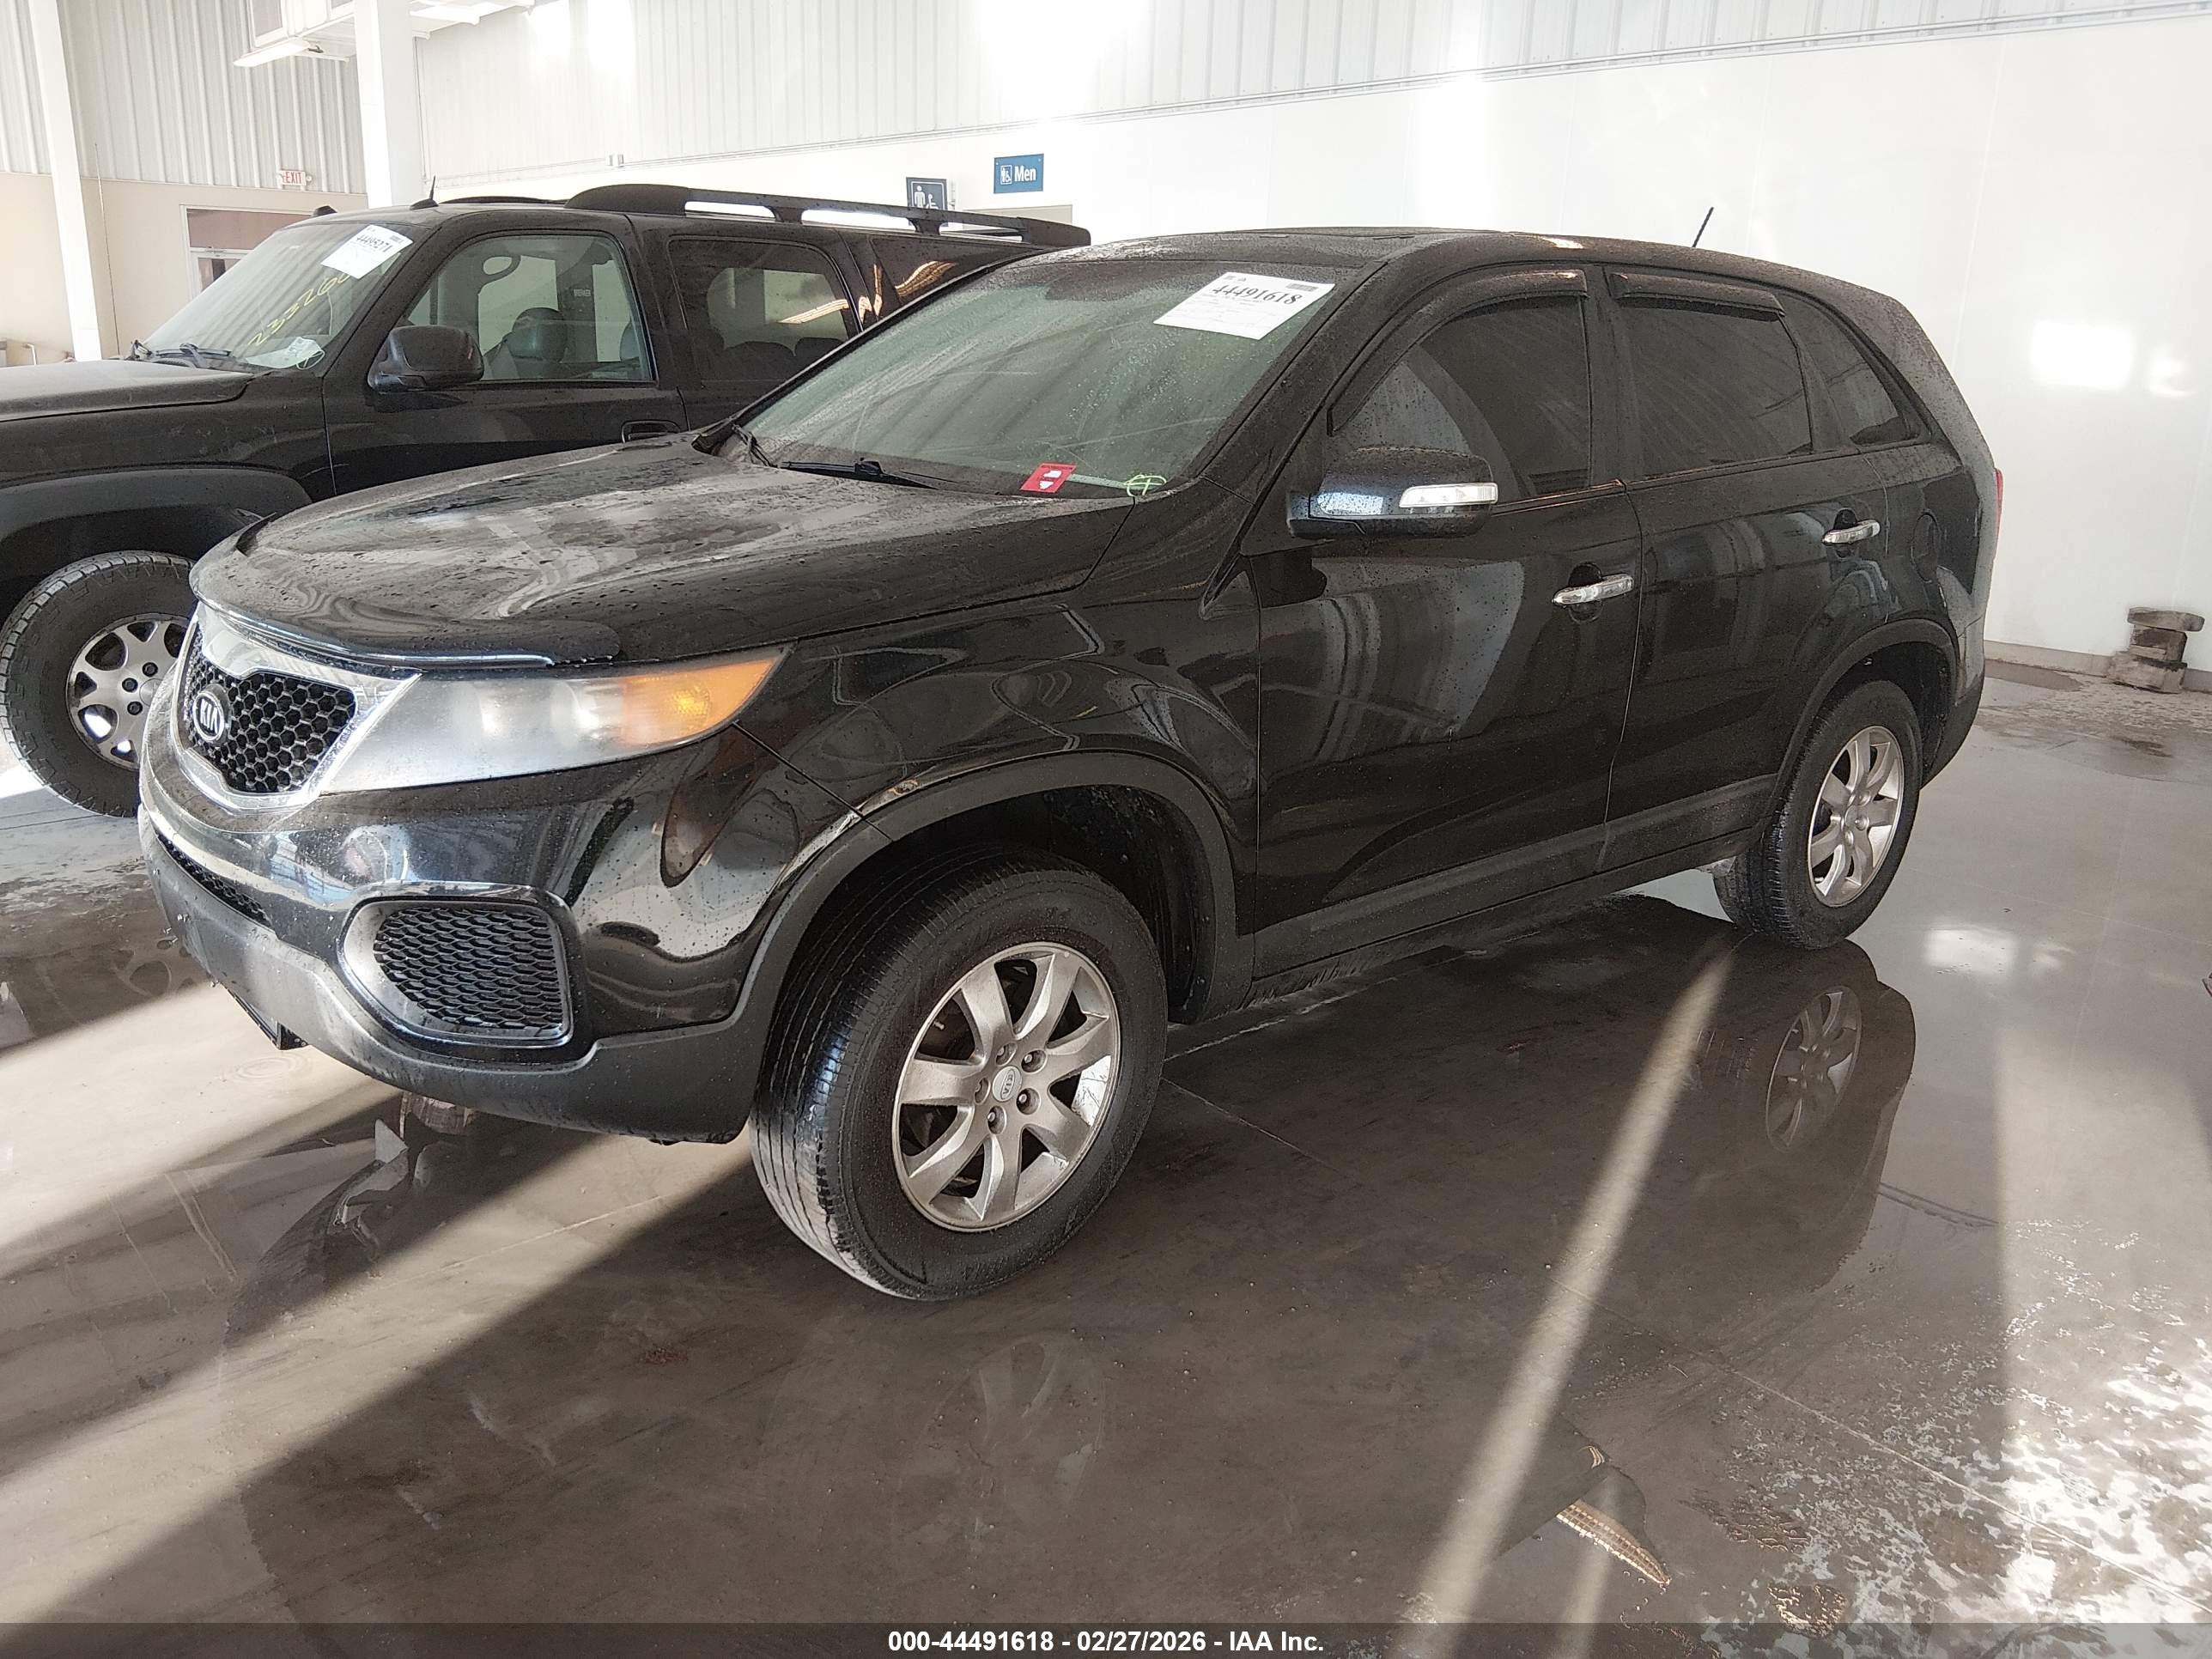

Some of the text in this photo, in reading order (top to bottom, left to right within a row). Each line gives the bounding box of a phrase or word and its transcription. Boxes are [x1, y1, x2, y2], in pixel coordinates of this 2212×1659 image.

[285, 171, 301, 184] EXIT
[1014, 165, 1036, 183] Men
[1212, 284, 1303, 305] 44491618
